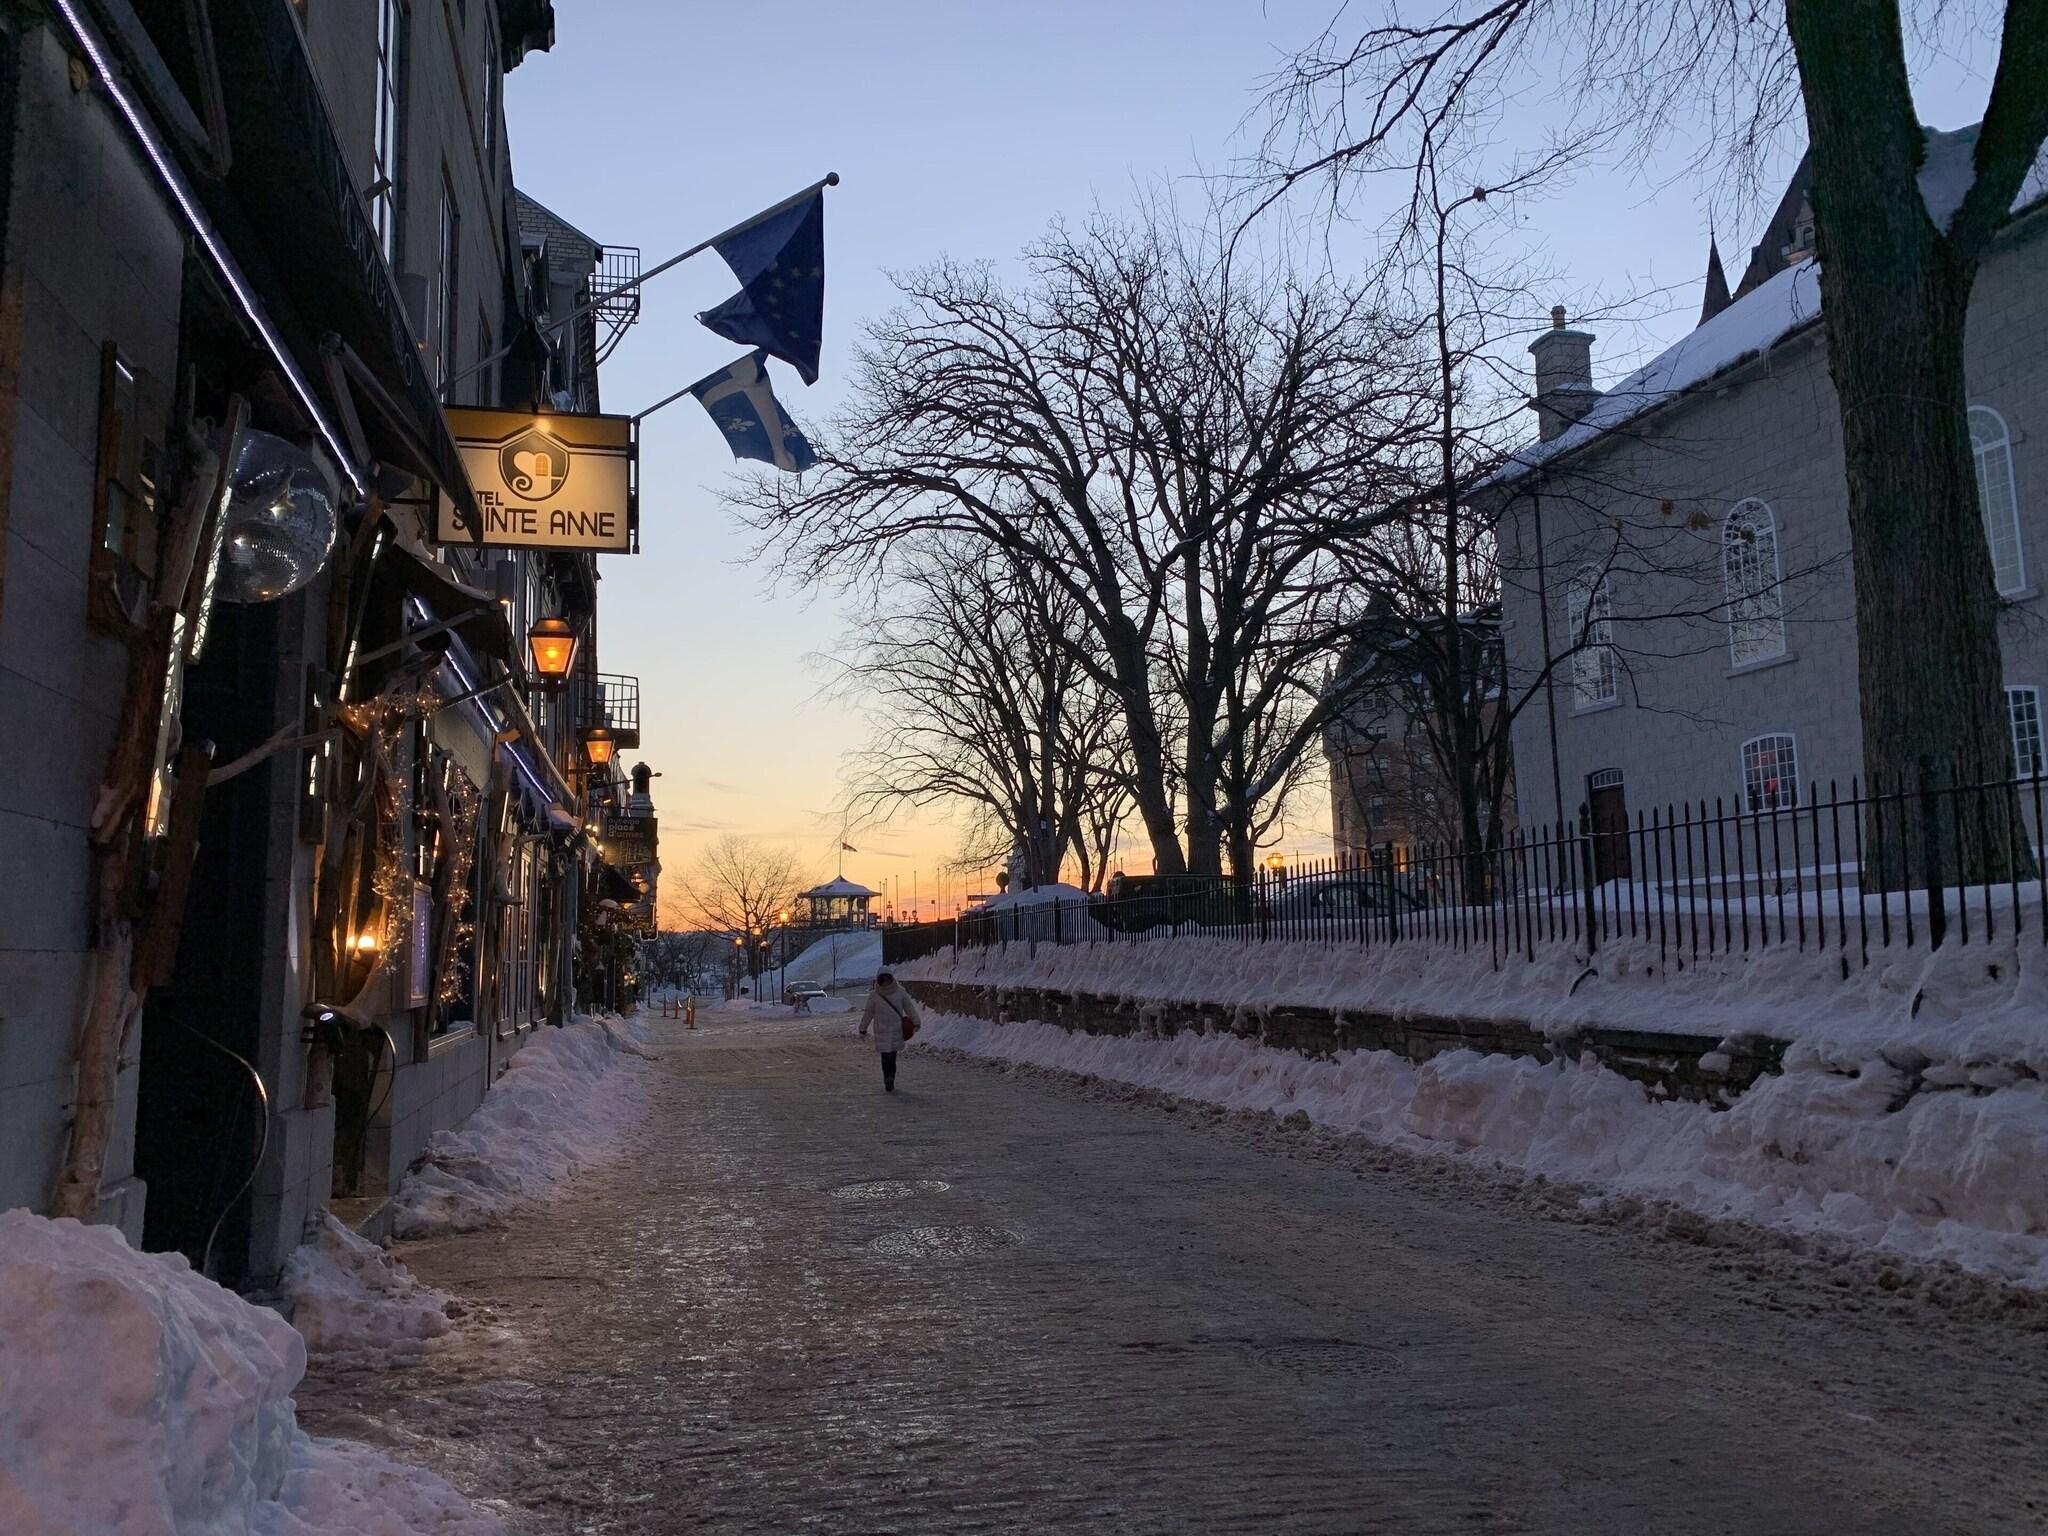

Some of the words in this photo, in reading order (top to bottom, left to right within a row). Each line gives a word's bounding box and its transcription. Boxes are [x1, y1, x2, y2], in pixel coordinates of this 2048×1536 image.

[477, 490, 504, 506] TEL
[452, 507, 537, 534] SINTE
[550, 510, 615, 537] ANNE
[608, 823, 635, 832] place
